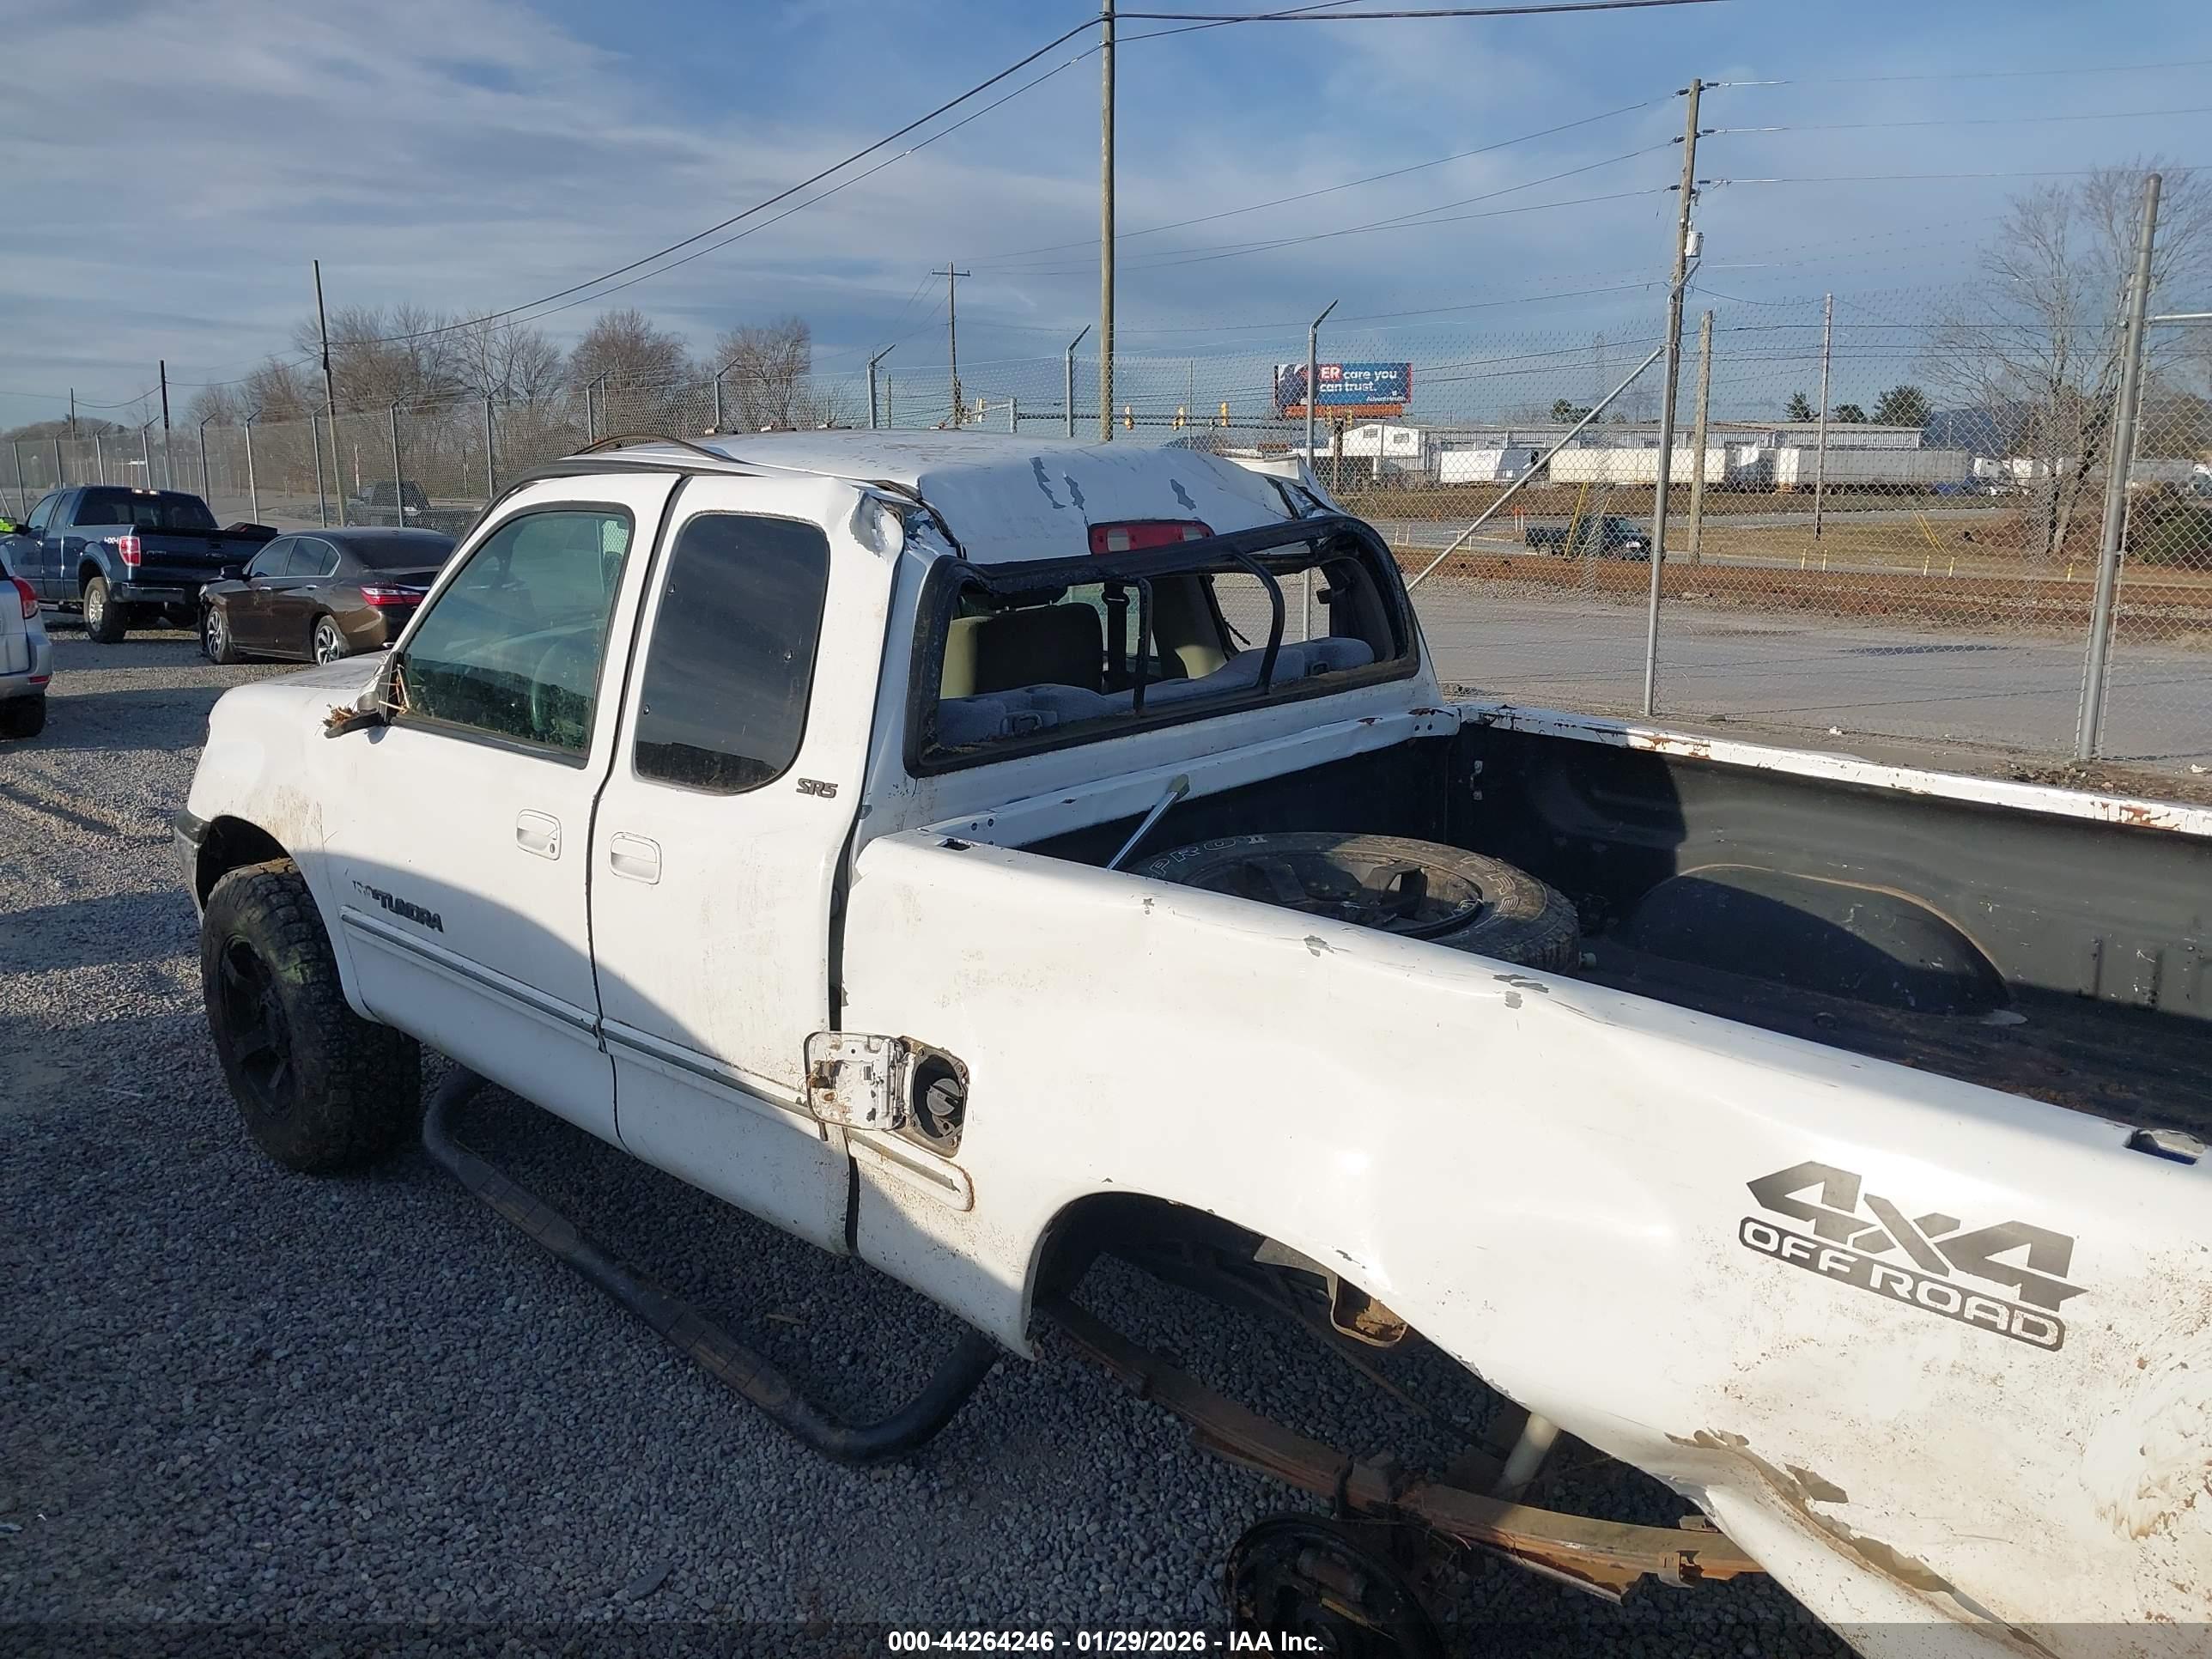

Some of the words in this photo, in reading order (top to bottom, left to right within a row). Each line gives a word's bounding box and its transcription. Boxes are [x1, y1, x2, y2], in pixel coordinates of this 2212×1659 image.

[1321, 367, 1340, 379] ER
[1344, 370, 1370, 380] care
[1374, 370, 1397, 381] you
[1319, 383, 1342, 392] can
[1345, 381, 1377, 392] trust.
[796, 778, 838, 799] SR5
[375, 889, 444, 933] TUNDRA
[1743, 1220, 1858, 1273] OFF
[1869, 1266, 2059, 1346] ROAD
